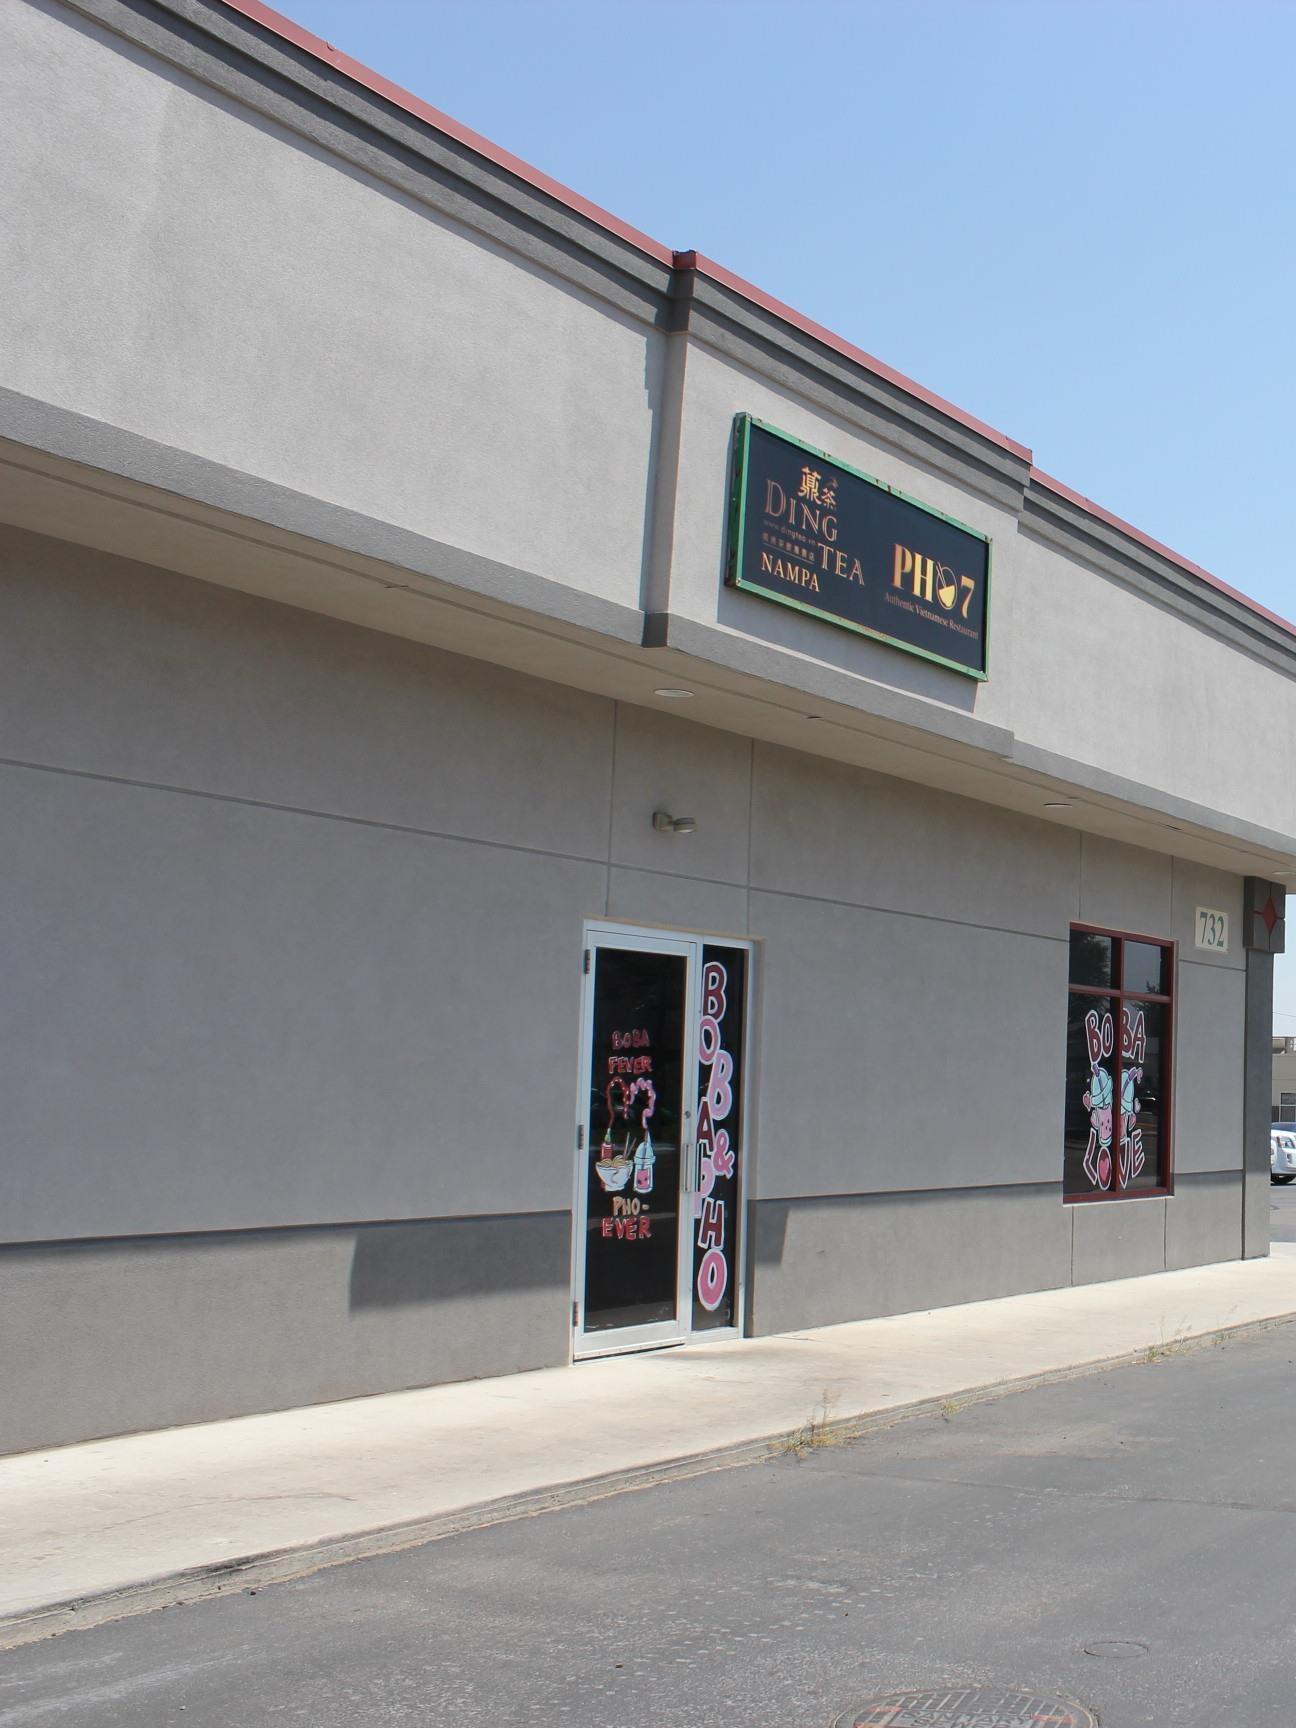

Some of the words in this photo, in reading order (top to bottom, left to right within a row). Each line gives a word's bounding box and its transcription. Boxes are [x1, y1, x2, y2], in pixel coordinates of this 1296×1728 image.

[764, 479, 838, 542] DING
[761, 551, 820, 592] NAMPA
[818, 542, 865, 586] TEA
[1199, 911, 1225, 947] 732
[1085, 1009, 1146, 1063] BOBA
[608, 1056, 653, 1074] FEVER
[1083, 1129, 1145, 1190] LOVE
[602, 1216, 652, 1240] EVER
